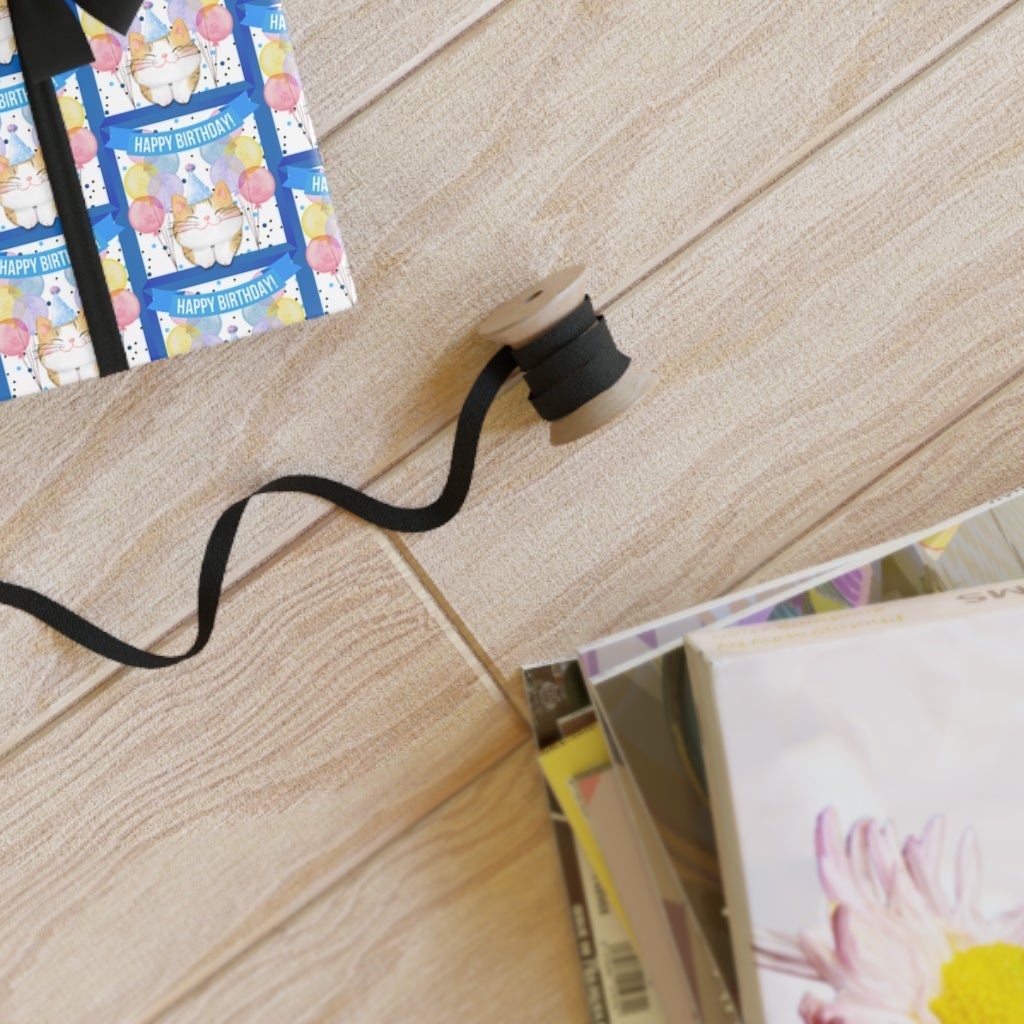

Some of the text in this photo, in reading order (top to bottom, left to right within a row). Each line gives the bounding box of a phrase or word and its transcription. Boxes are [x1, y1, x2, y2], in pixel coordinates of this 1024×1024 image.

[134, 113, 235, 153] HAPPY BIRTHDAY!
[0, 257, 37, 275] HAPPY
[177, 275, 277, 316] HAPPY BIRTHDAY!
